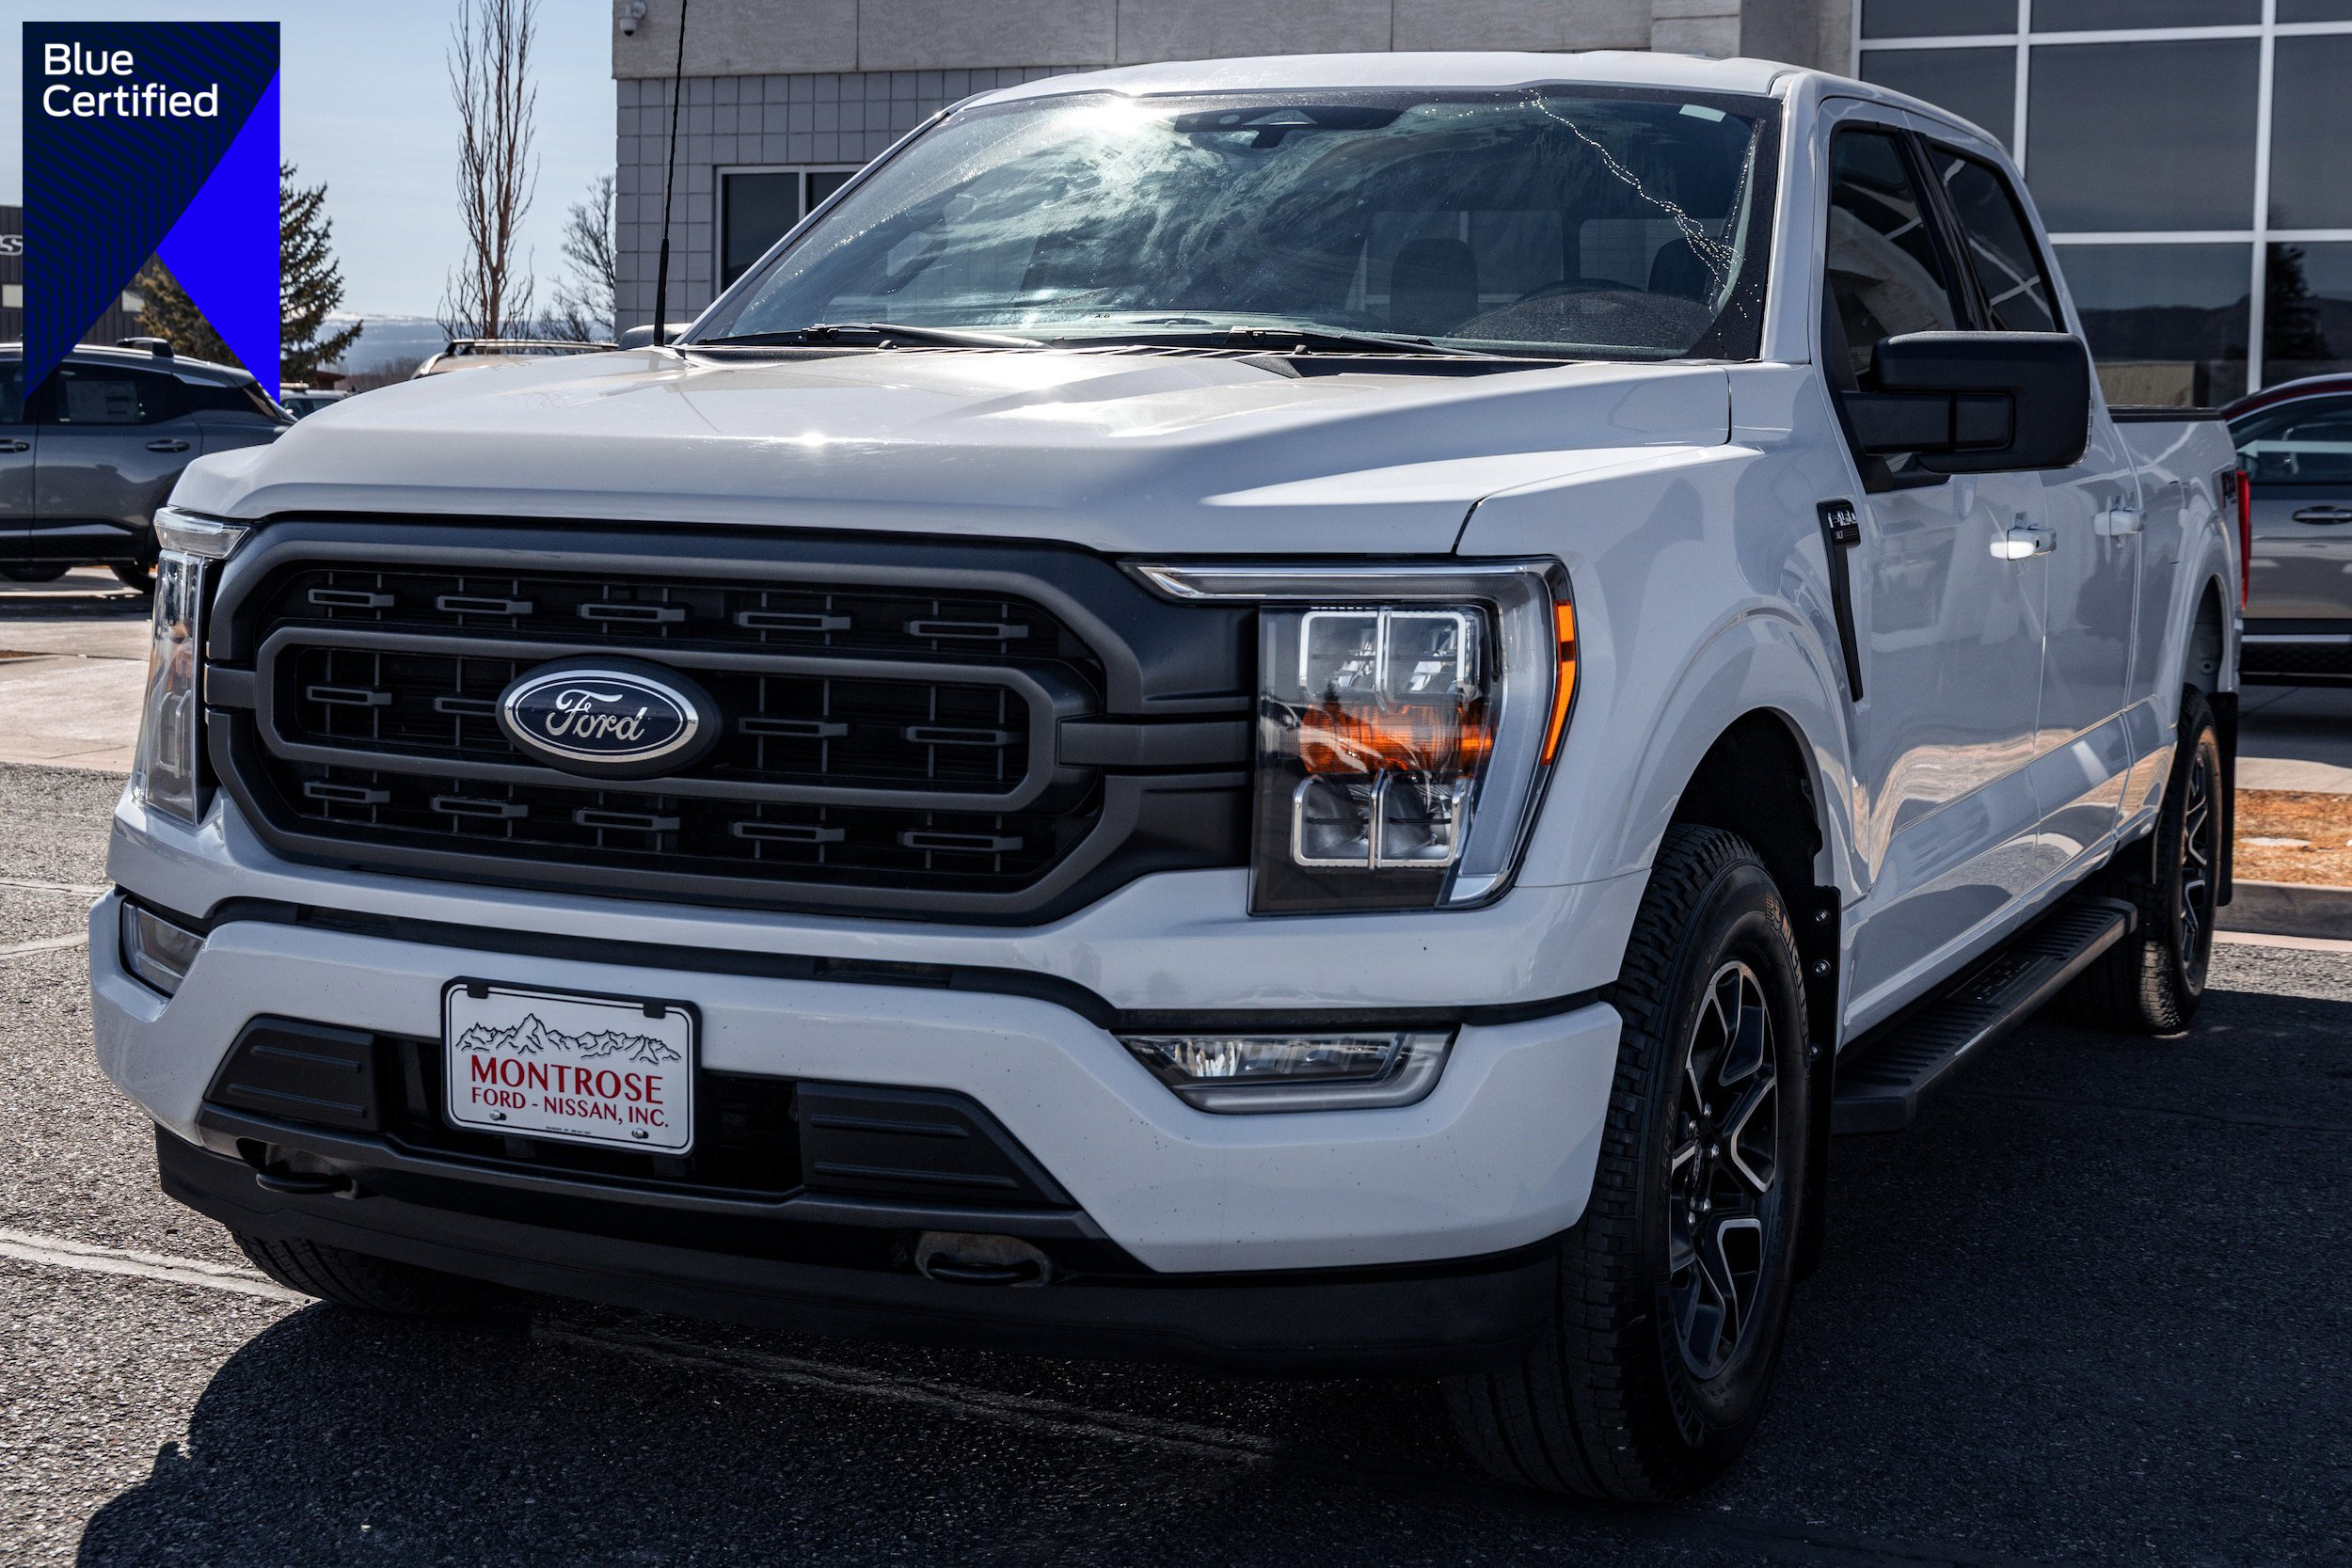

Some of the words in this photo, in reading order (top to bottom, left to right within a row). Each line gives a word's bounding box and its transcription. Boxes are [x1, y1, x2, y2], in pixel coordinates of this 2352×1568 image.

[545, 689, 649, 741] Ford
[471, 1054, 664, 1105] MONTROSE
[471, 1087, 527, 1110] FORD
[544, 1096, 623, 1126] NISSAN,
[628, 1106, 669, 1128] INC.
